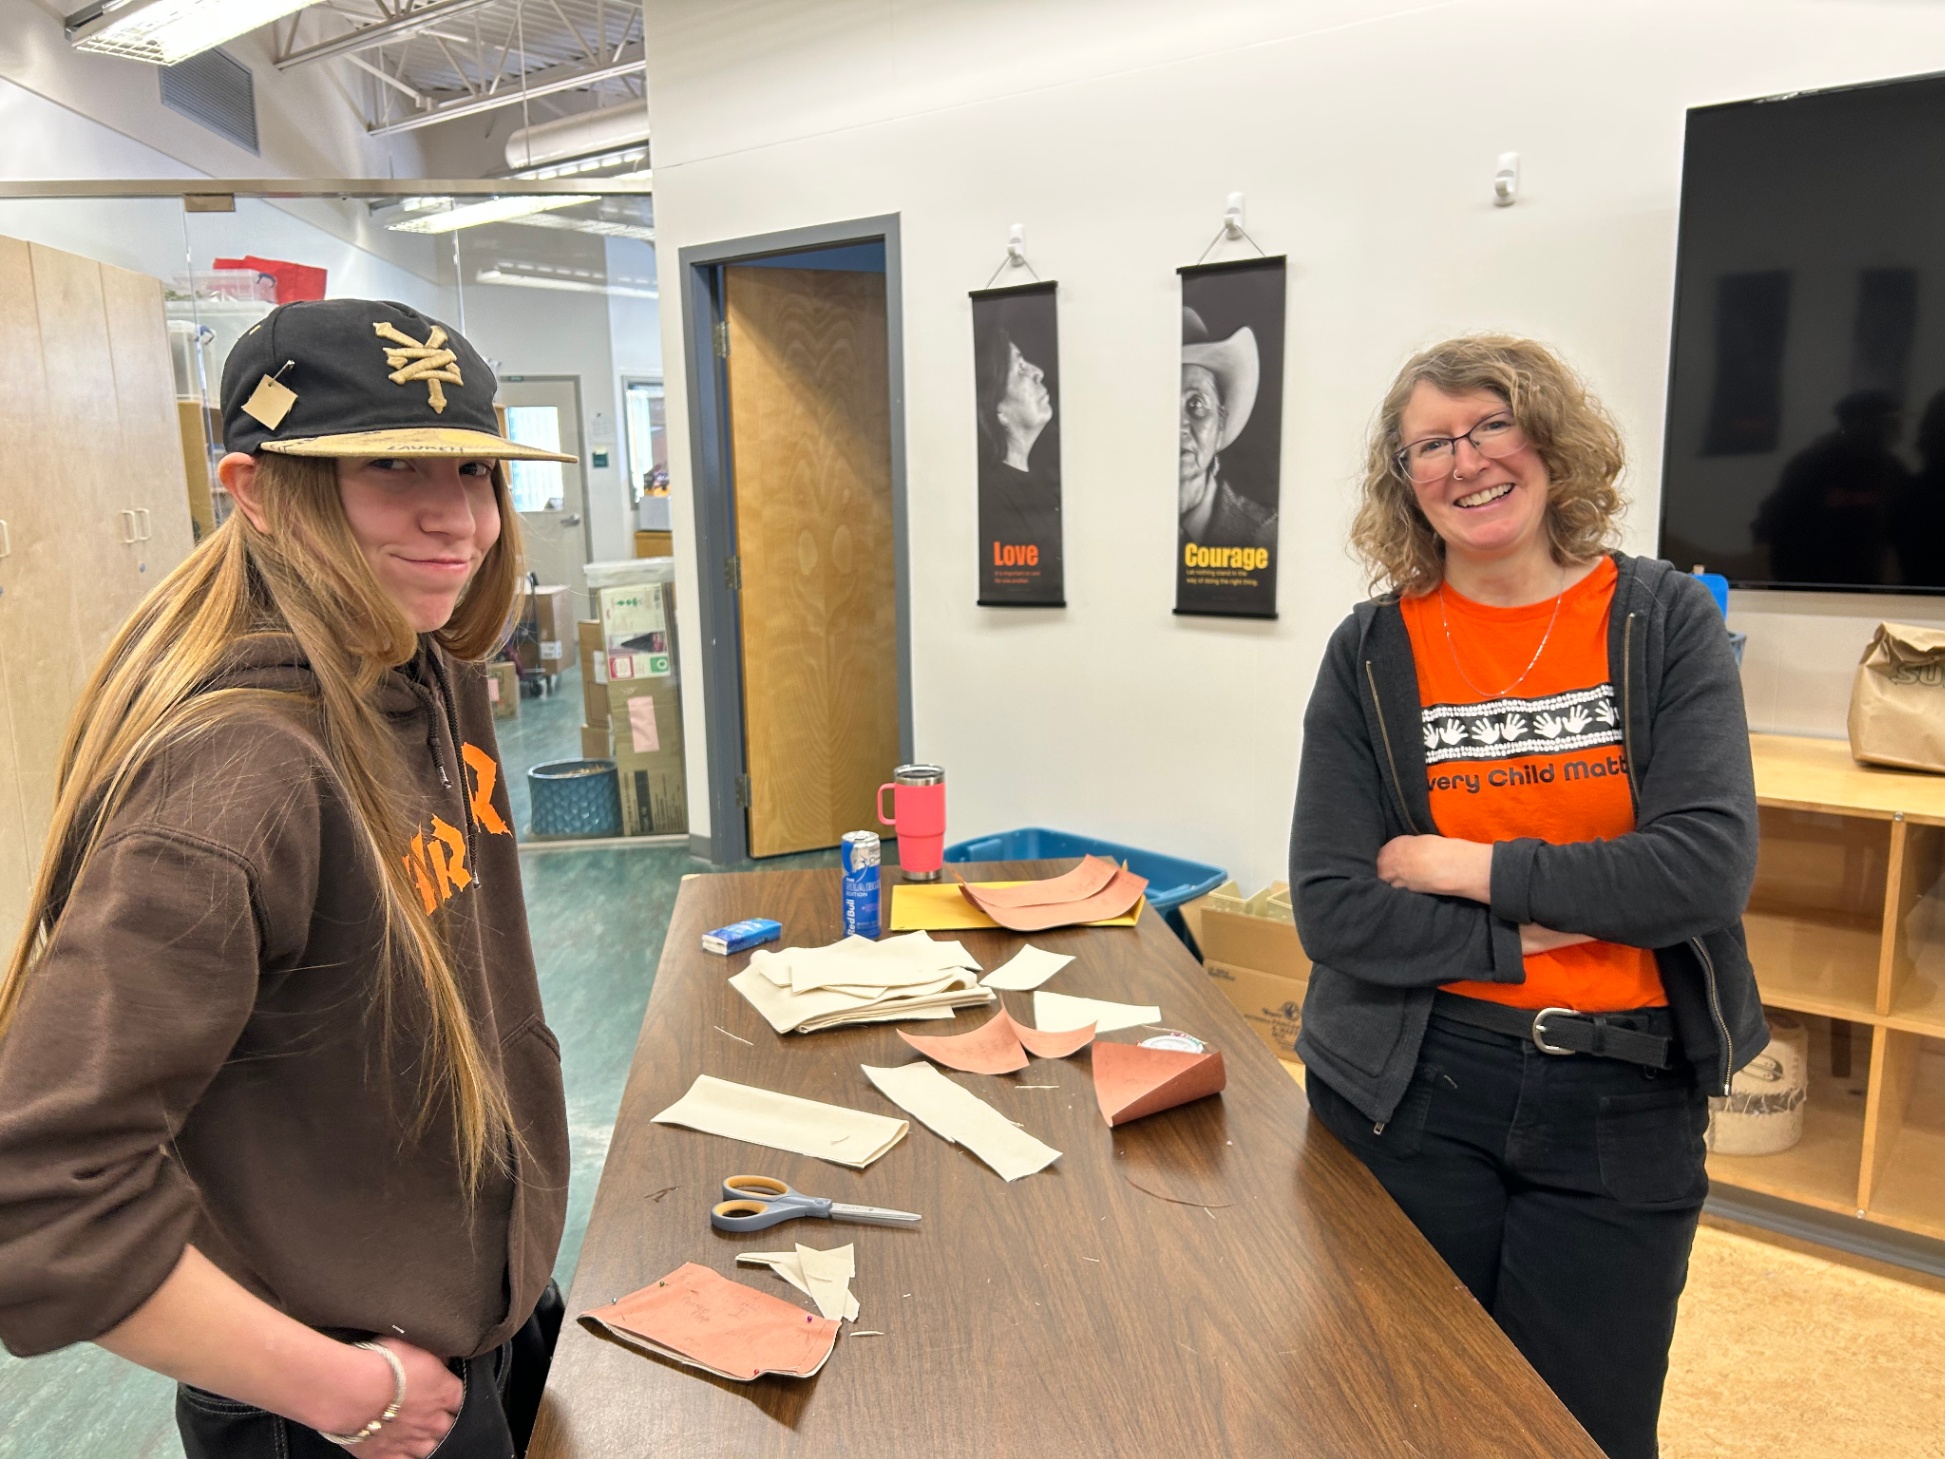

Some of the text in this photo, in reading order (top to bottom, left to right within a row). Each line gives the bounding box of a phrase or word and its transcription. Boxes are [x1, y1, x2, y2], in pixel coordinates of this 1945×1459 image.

[993, 541, 1039, 567] Love
[1185, 543, 1269, 571] Courage
[1890, 662, 1945, 688] SU
[1427, 755, 1629, 794] very Child Matt
[846, 899, 856, 935] Red Bull
